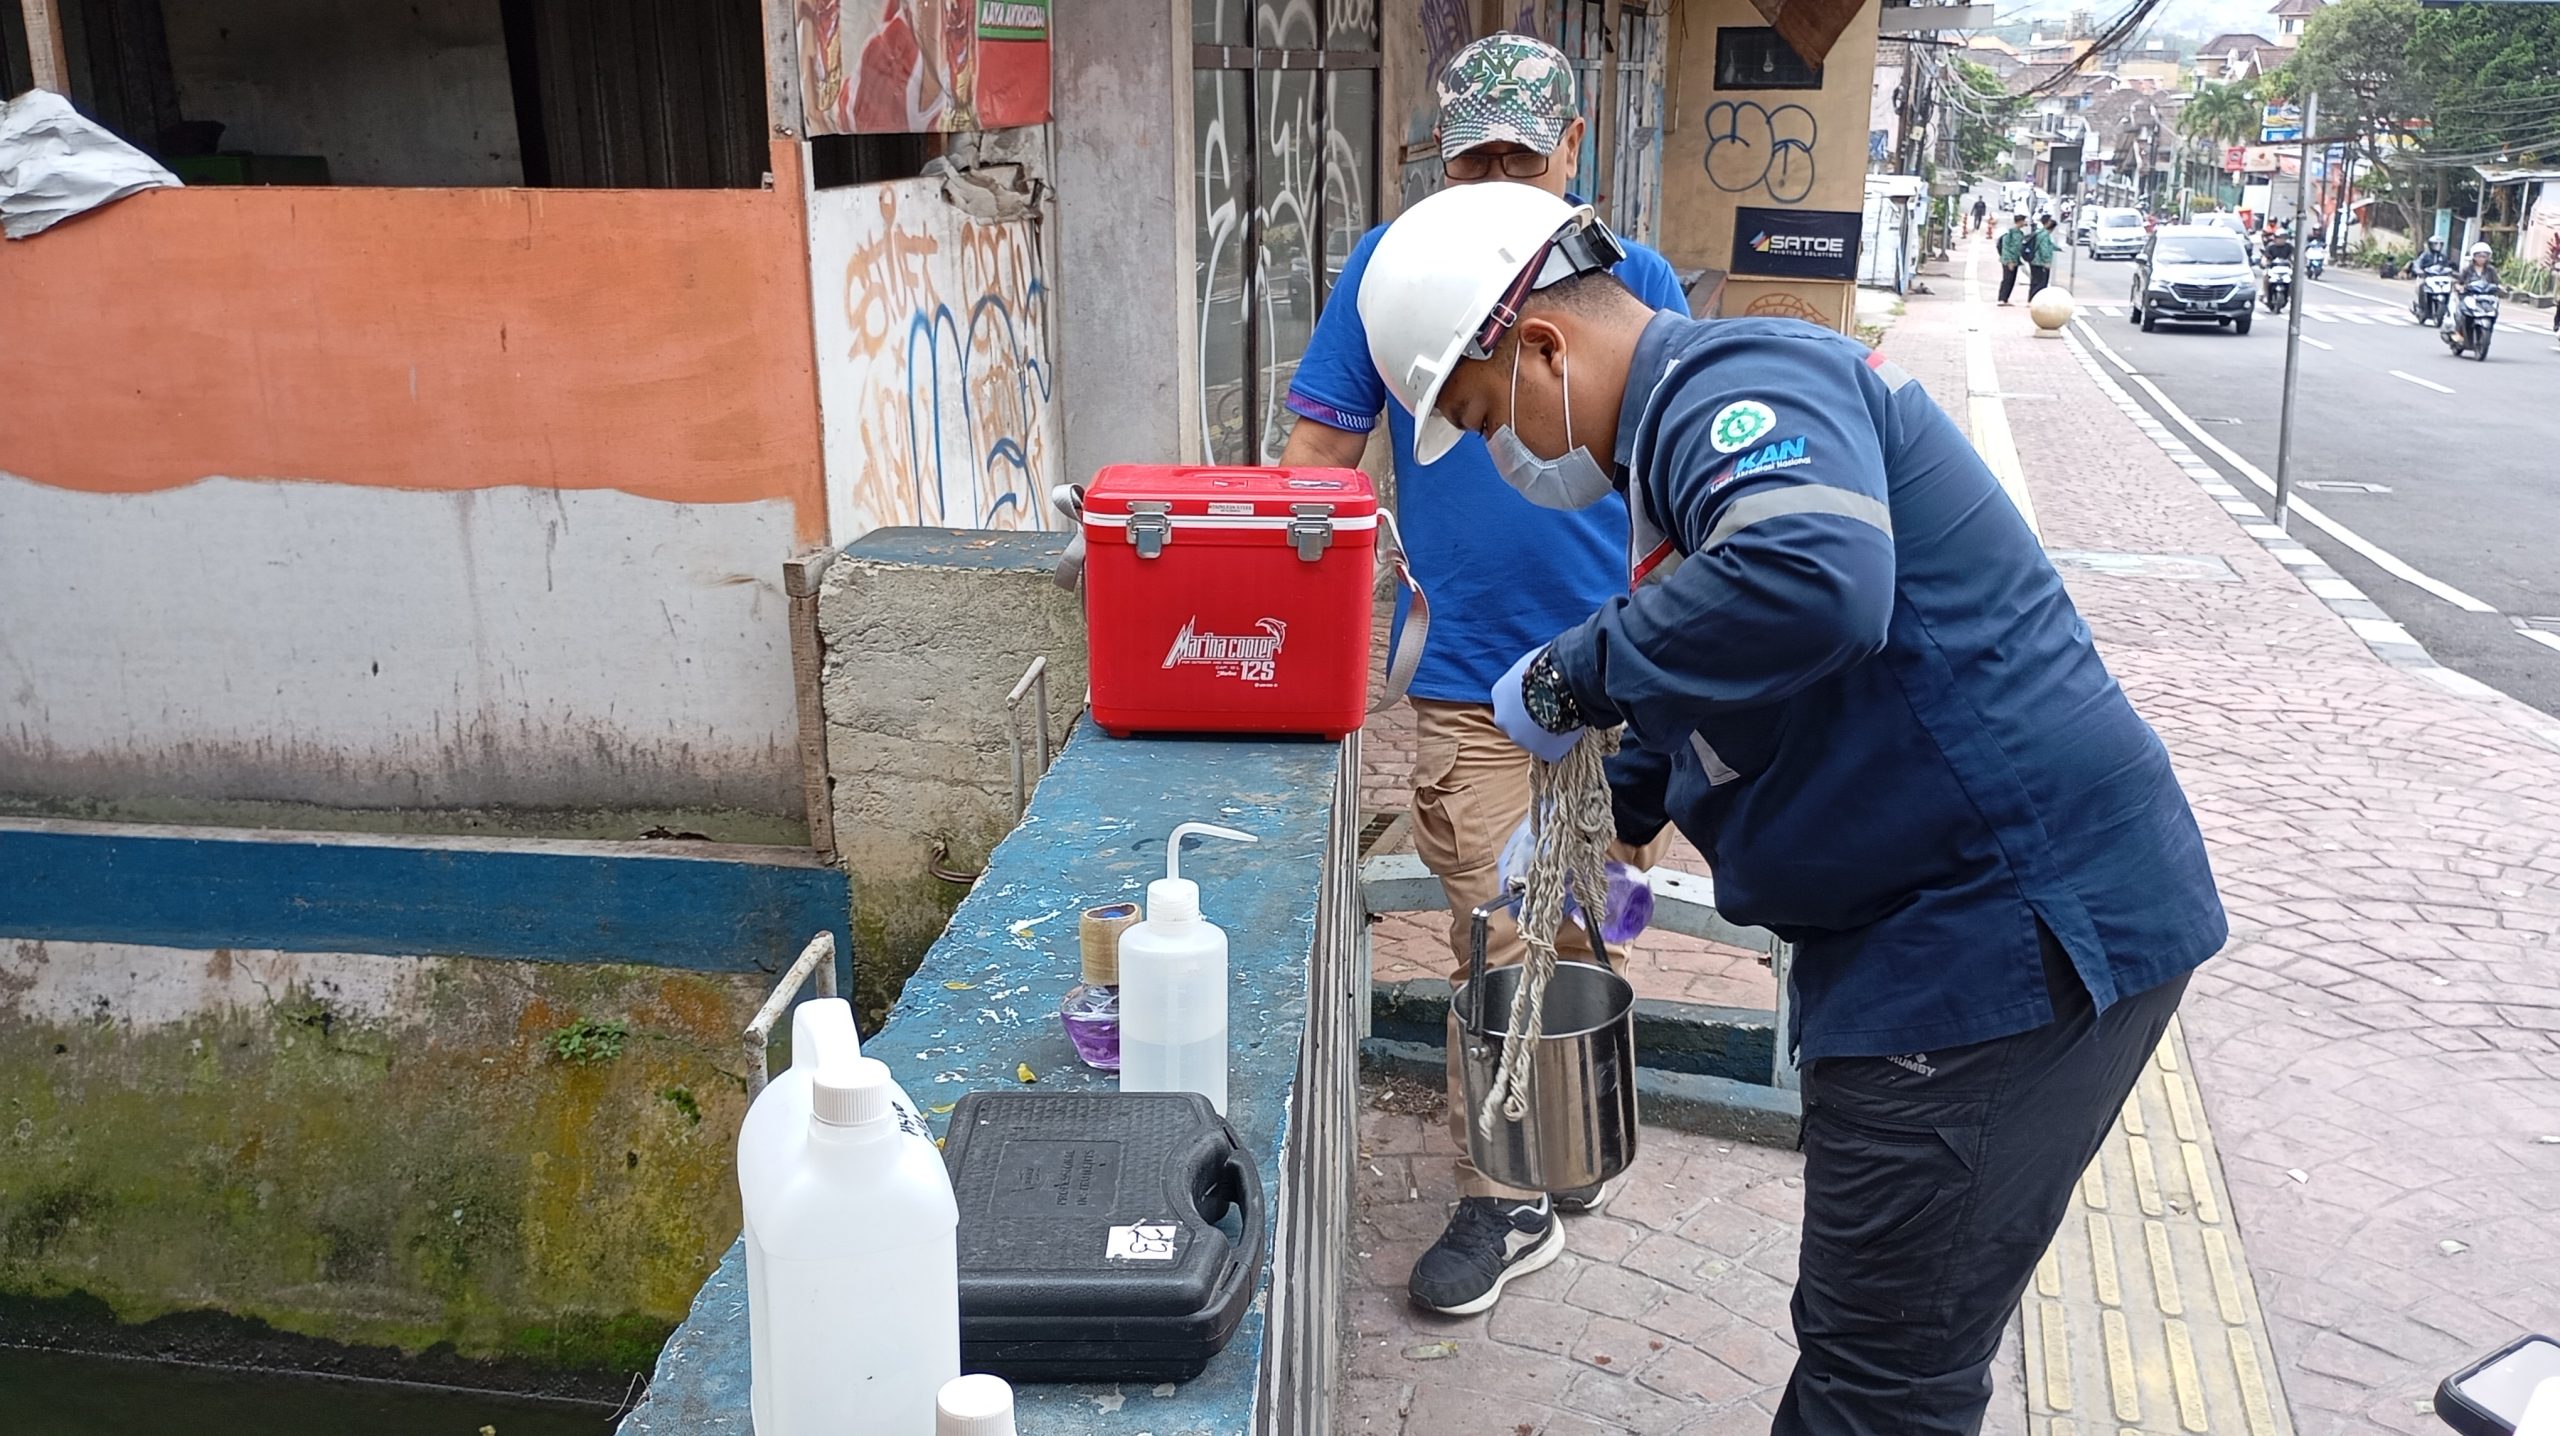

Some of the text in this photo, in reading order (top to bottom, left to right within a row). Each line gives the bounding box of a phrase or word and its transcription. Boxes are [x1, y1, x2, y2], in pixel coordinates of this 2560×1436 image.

[1770, 235, 1844, 252] SATOE
[1734, 436, 1805, 474] KAN
[1240, 661, 1275, 680] 12S
